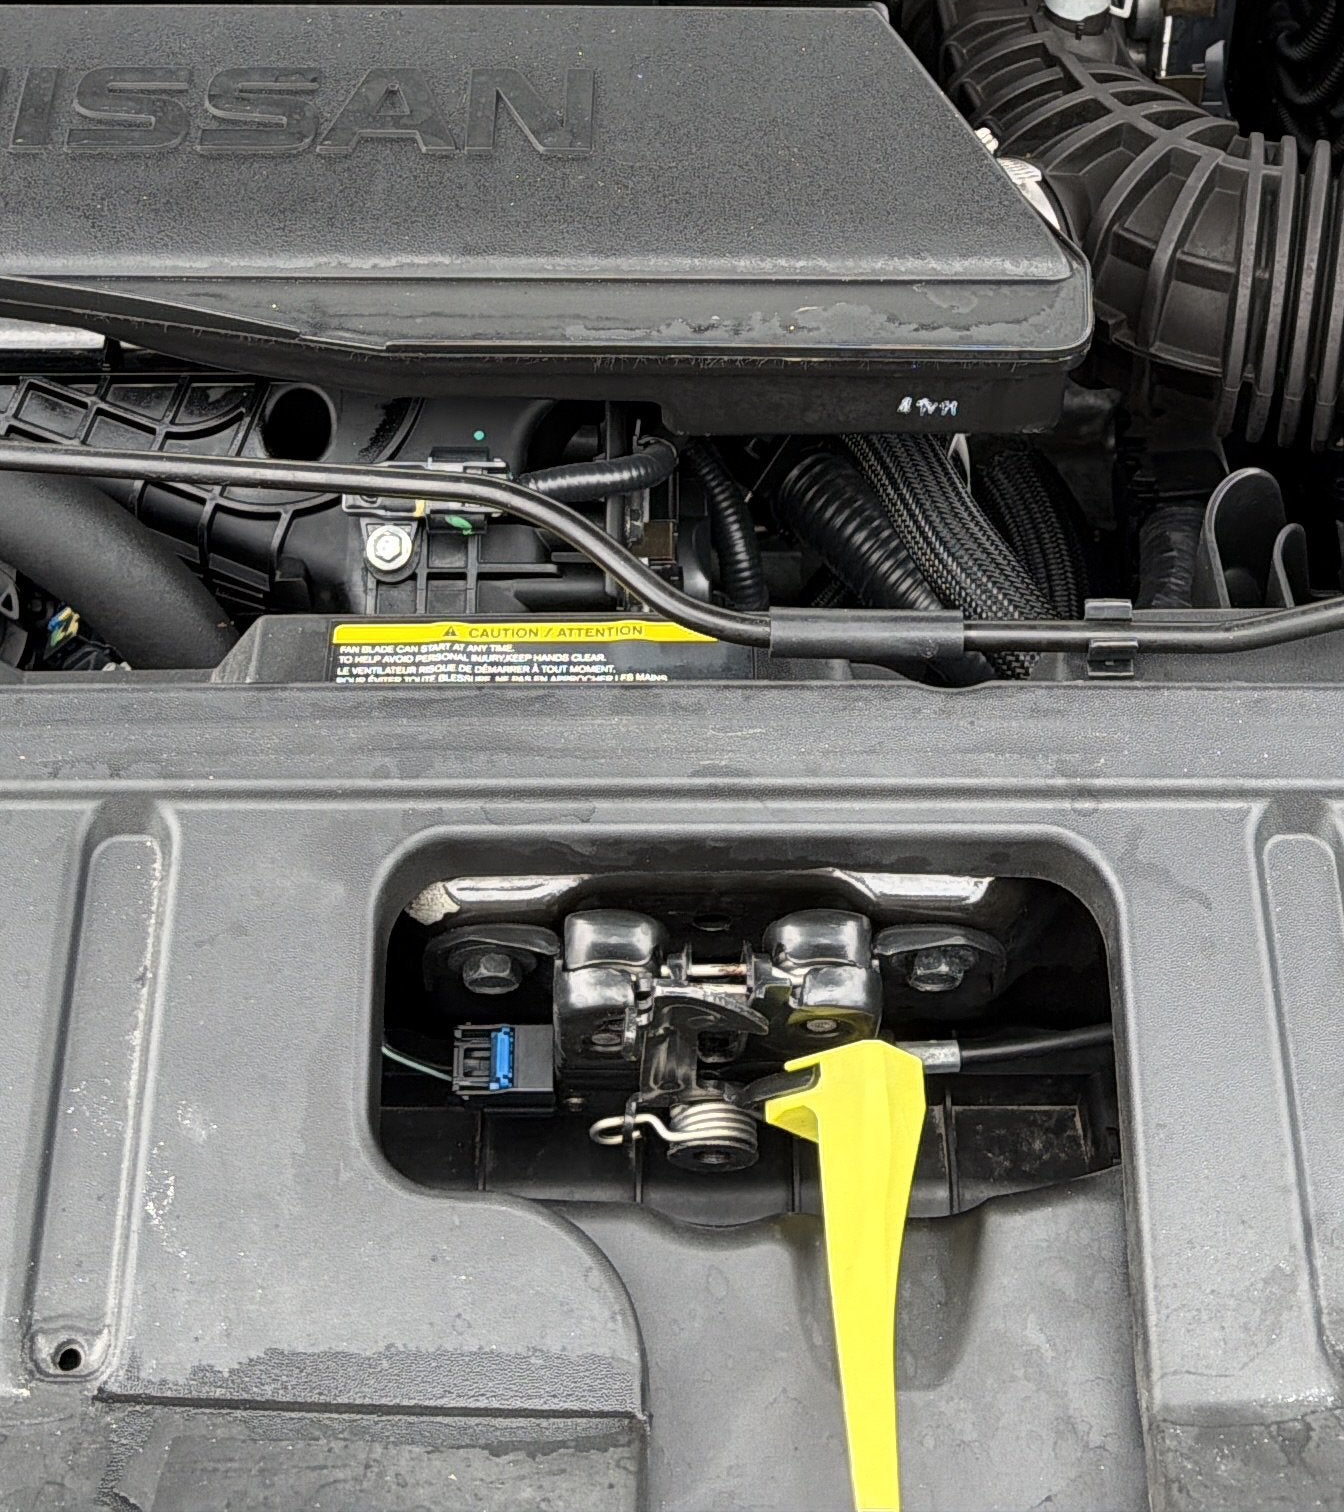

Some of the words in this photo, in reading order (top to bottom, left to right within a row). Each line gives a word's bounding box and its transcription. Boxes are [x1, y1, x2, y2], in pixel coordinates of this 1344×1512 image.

[468, 627, 539, 638] CAUTION
[557, 625, 643, 638] ATTENTION
[340, 645, 360, 653] FAN
[361, 645, 394, 653] BLADE
[396, 645, 418, 653] CAN
[421, 643, 451, 653] START
[452, 643, 465, 652] AT
[466, 644, 488, 652] ANY
[339, 656, 353, 664] TO
[355, 656, 381, 664] HELP
[382, 655, 414, 663] AVOID
[415, 653, 469, 663] PERSONAL
[533, 654, 569, 662] HANDS
[571, 654, 607, 662] CLEAR.
[337, 667, 350, 675] LE
[352, 666, 417, 675] VENTILATEUR
[419, 664, 457, 674] RISQUE
[458, 665, 472, 673] DE
[474, 663, 530, 673] DÉMARRER
[541, 665, 568, 673] TOUT
[569, 665, 616, 673] MOMENT.
